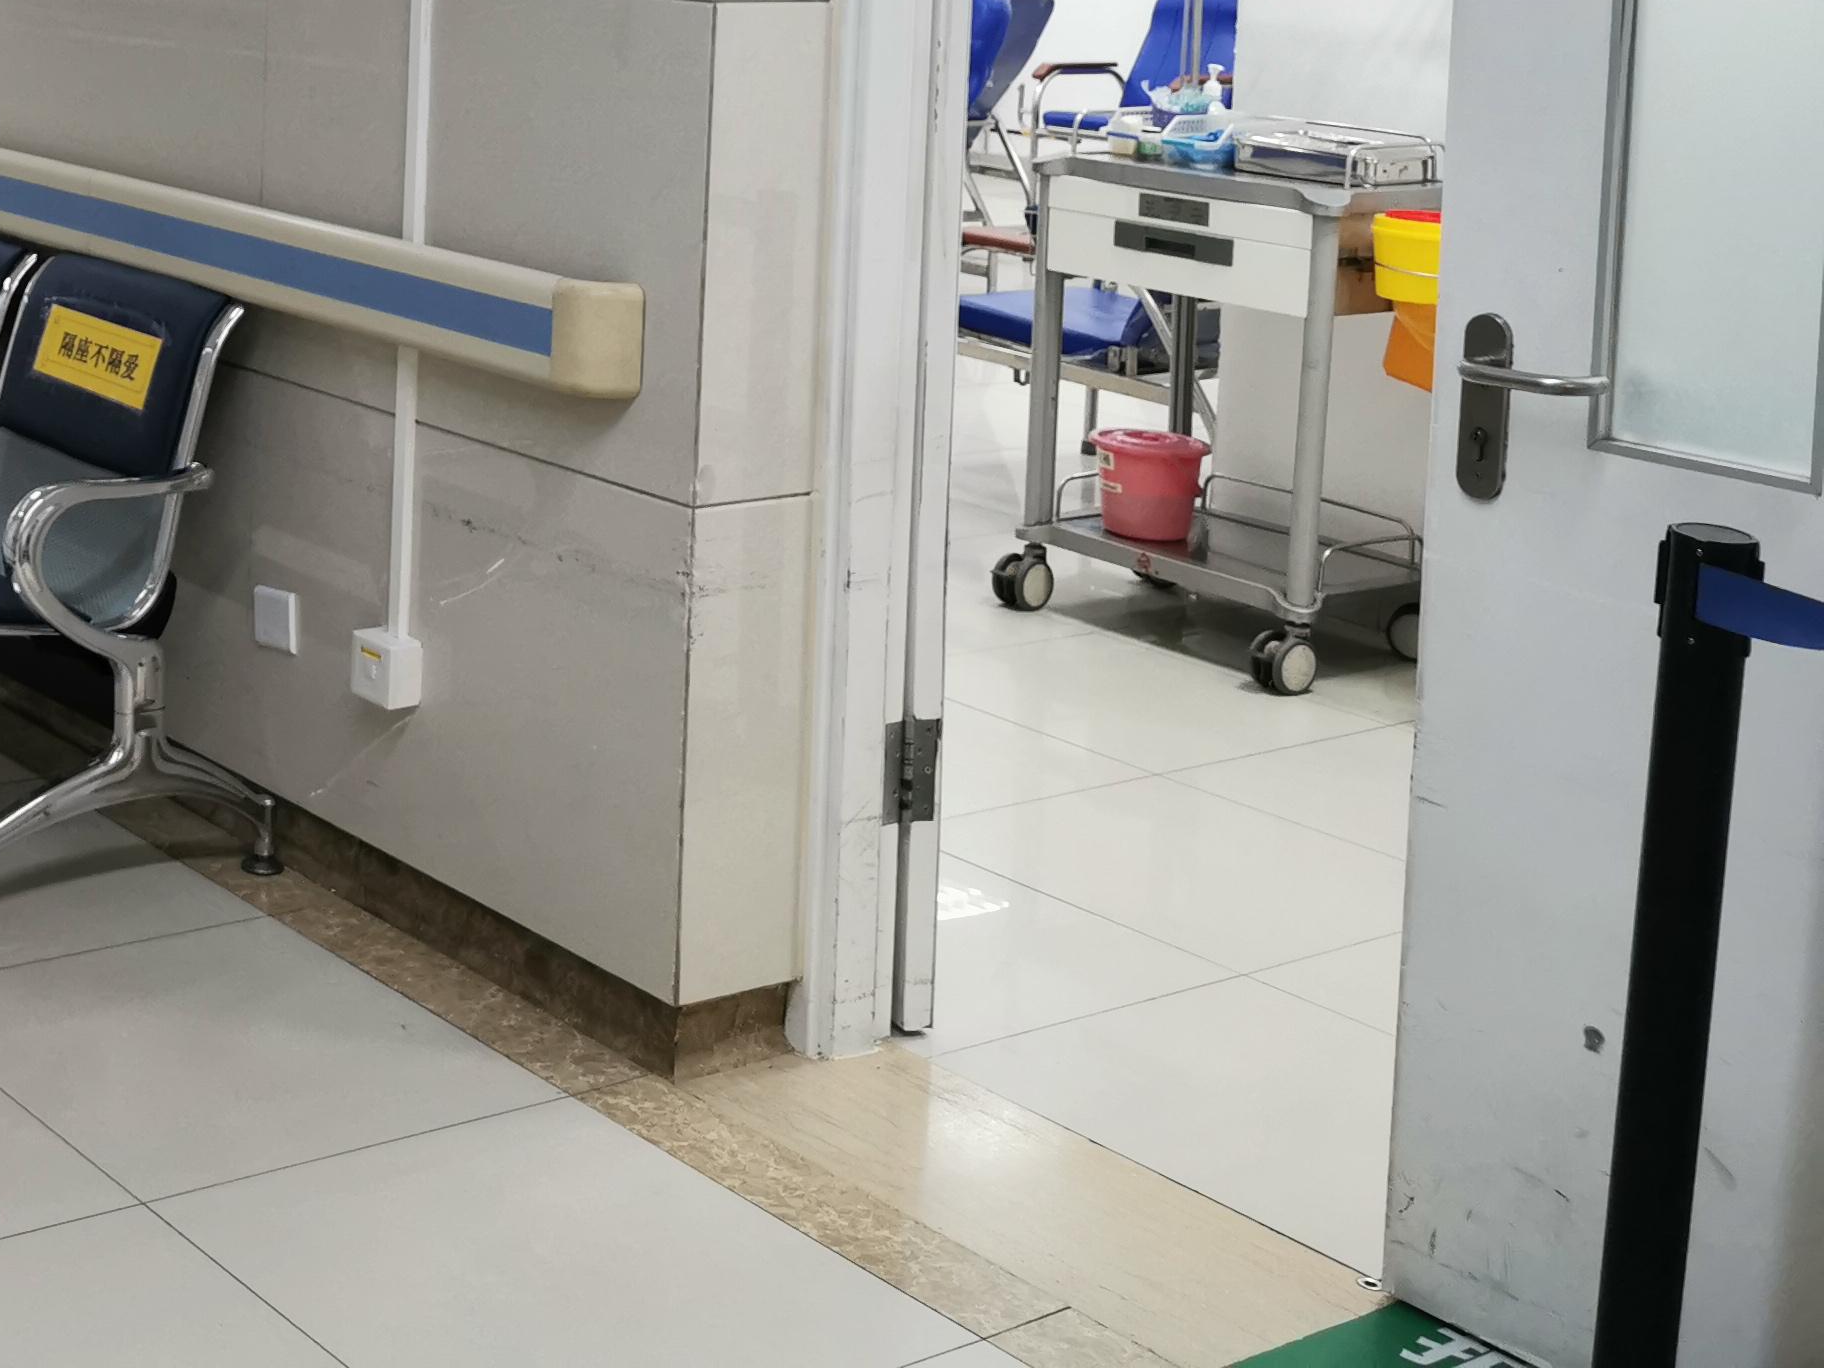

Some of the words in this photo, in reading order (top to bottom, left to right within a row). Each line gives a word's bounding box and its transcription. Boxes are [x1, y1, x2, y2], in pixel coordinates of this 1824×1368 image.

[57, 331, 140, 382] 隔座不隔爱
